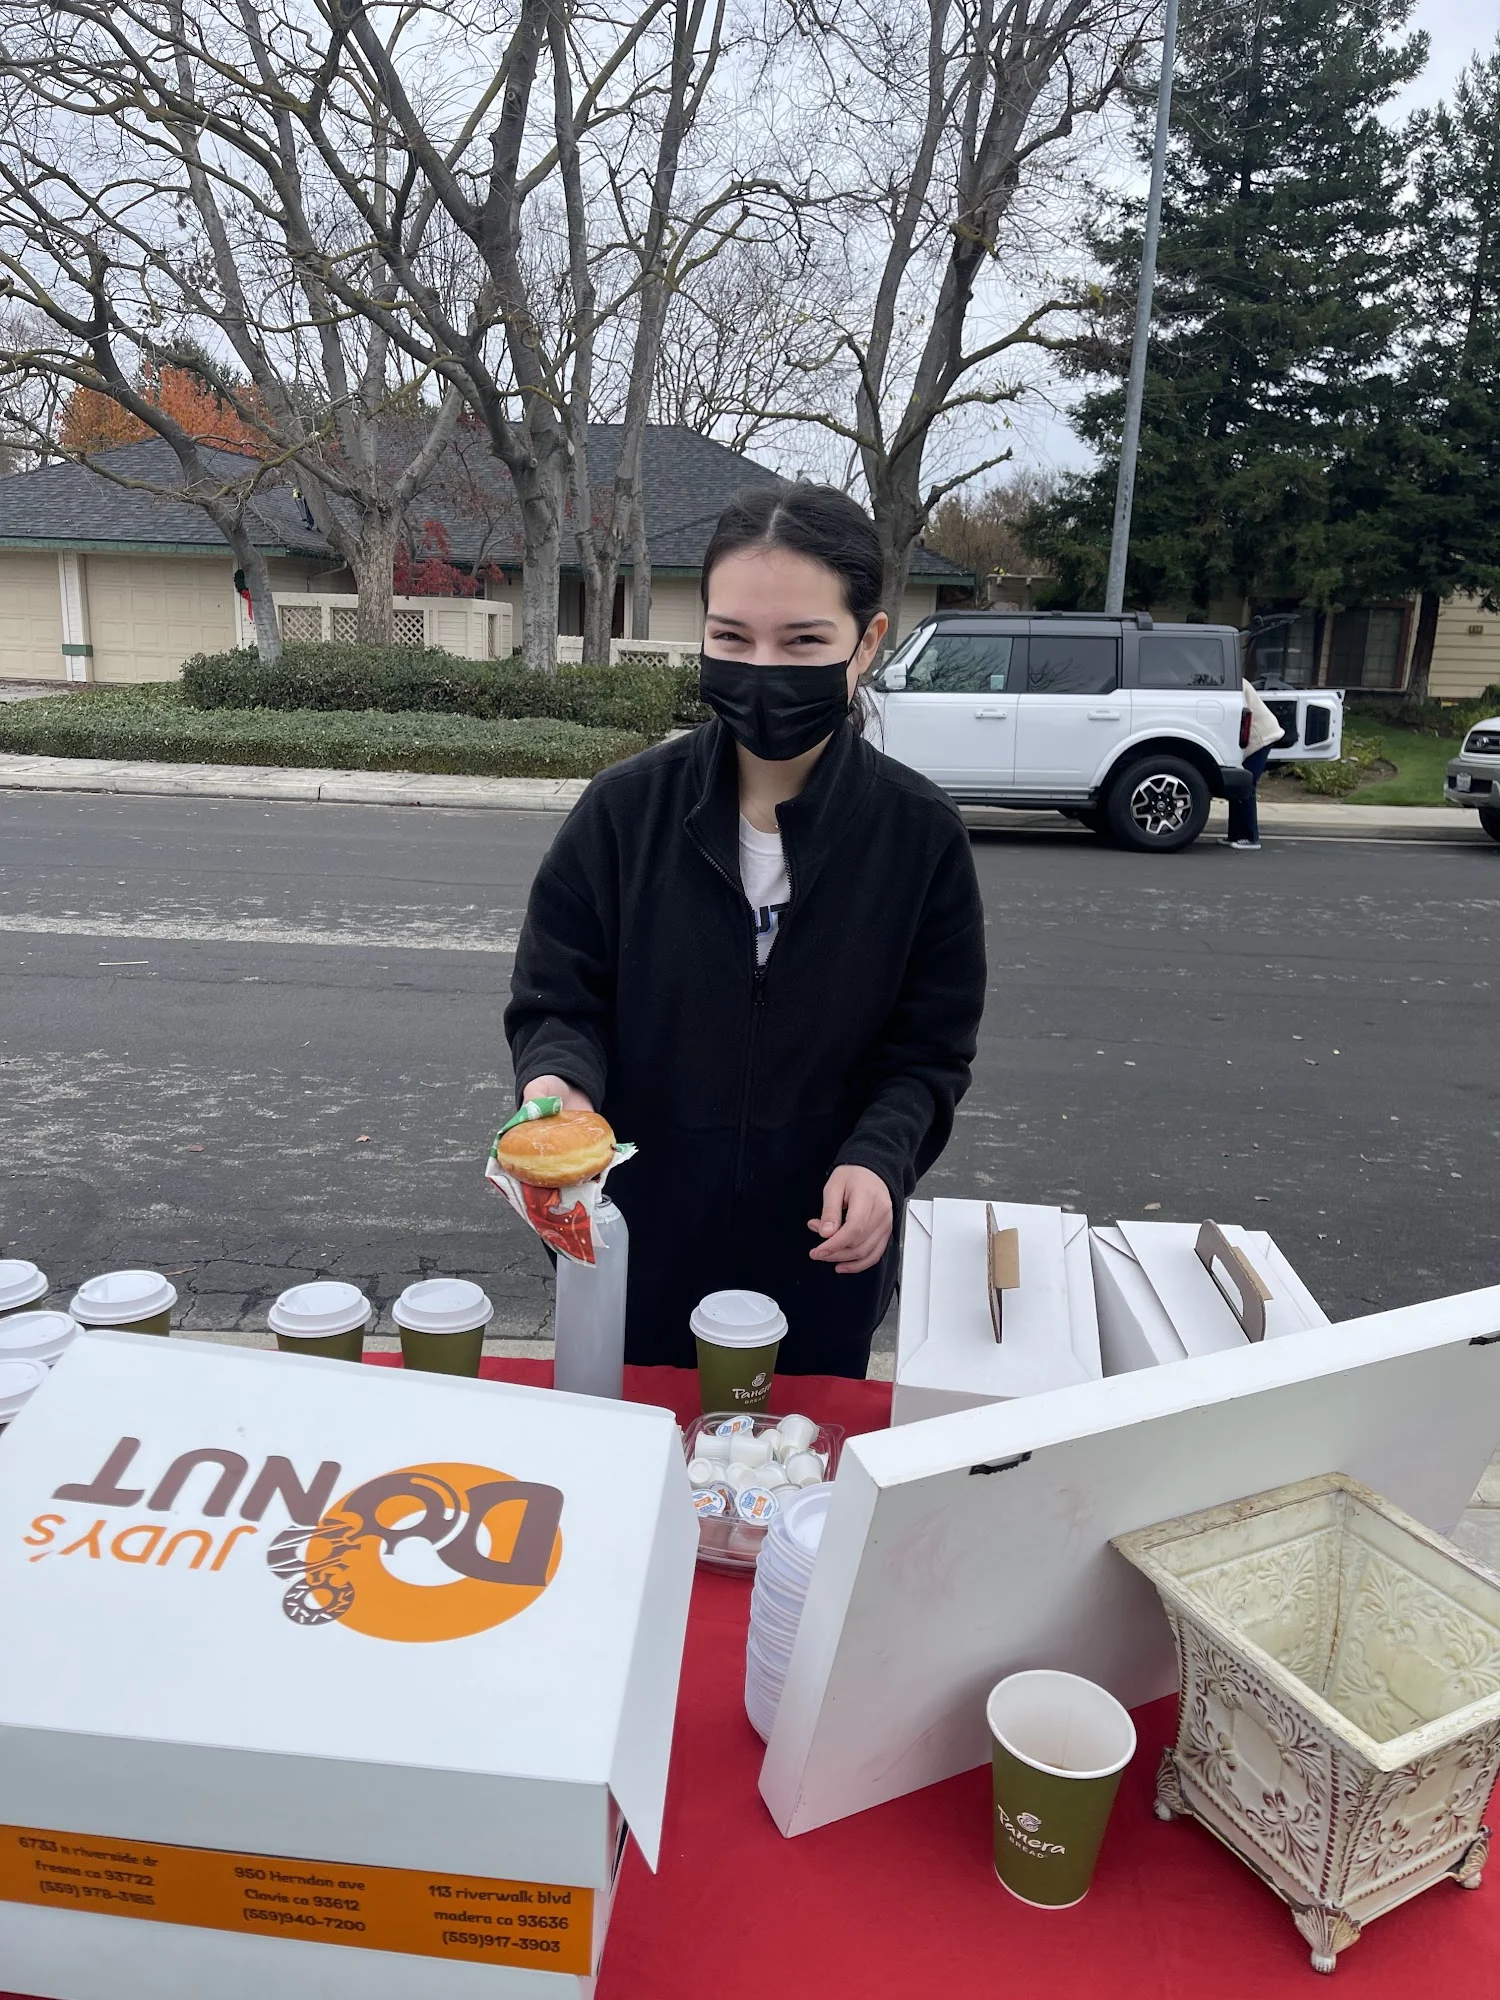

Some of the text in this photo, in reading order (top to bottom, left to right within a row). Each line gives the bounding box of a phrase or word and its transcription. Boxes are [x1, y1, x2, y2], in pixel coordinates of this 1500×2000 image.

[997, 1804, 1066, 1855] Panera
[1008, 1835, 1045, 1859] BREAD
[142, 1855, 159, 1867] dr
[85, 1869, 102, 1879] ca
[104, 1870, 155, 1887] 93722
[233, 1866, 366, 1891] 950 Herndon ave
[244, 1889, 360, 1911] Clovis ca 93612
[428, 1885, 572, 1905] 113 riverwalk blvd
[434, 1911, 569, 1930] madera ca 93636
[442, 1931, 561, 1953] (559)917-3903
